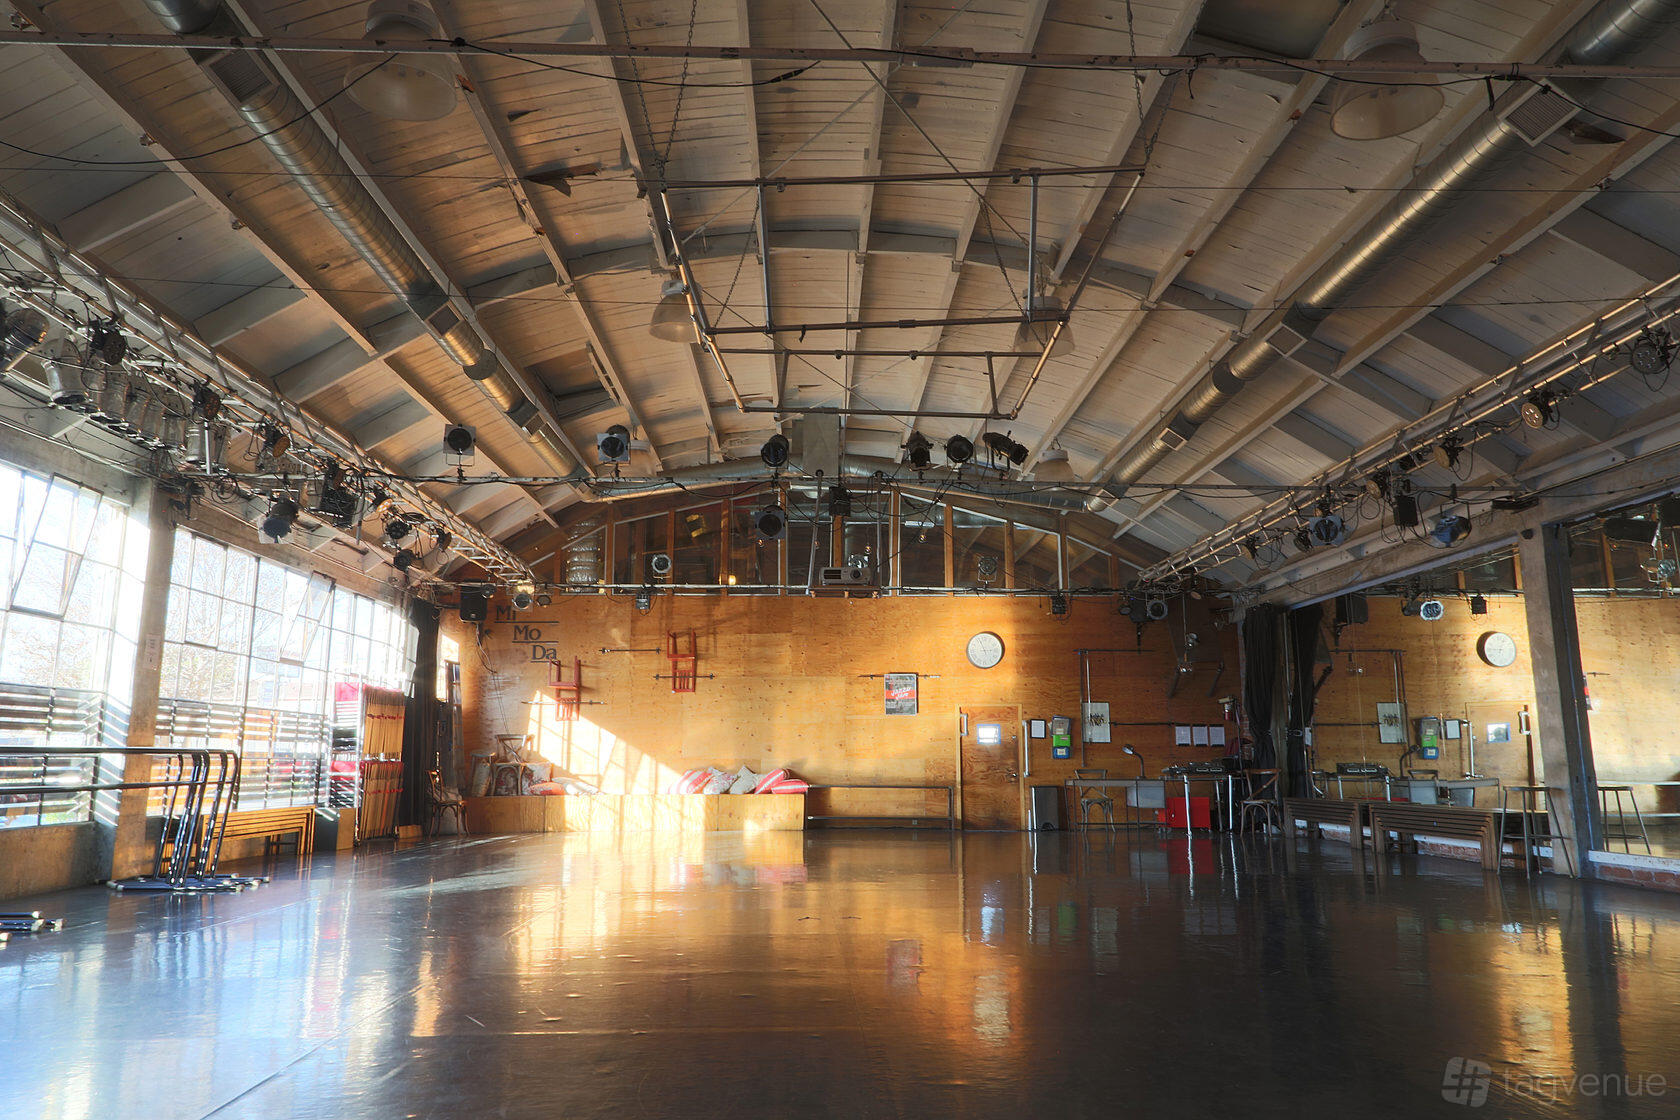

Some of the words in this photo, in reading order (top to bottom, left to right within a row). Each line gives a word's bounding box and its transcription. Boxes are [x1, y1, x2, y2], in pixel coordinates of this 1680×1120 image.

[496, 605, 517, 620] Mi
[513, 624, 542, 641] Mo
[531, 644, 557, 660] Da
